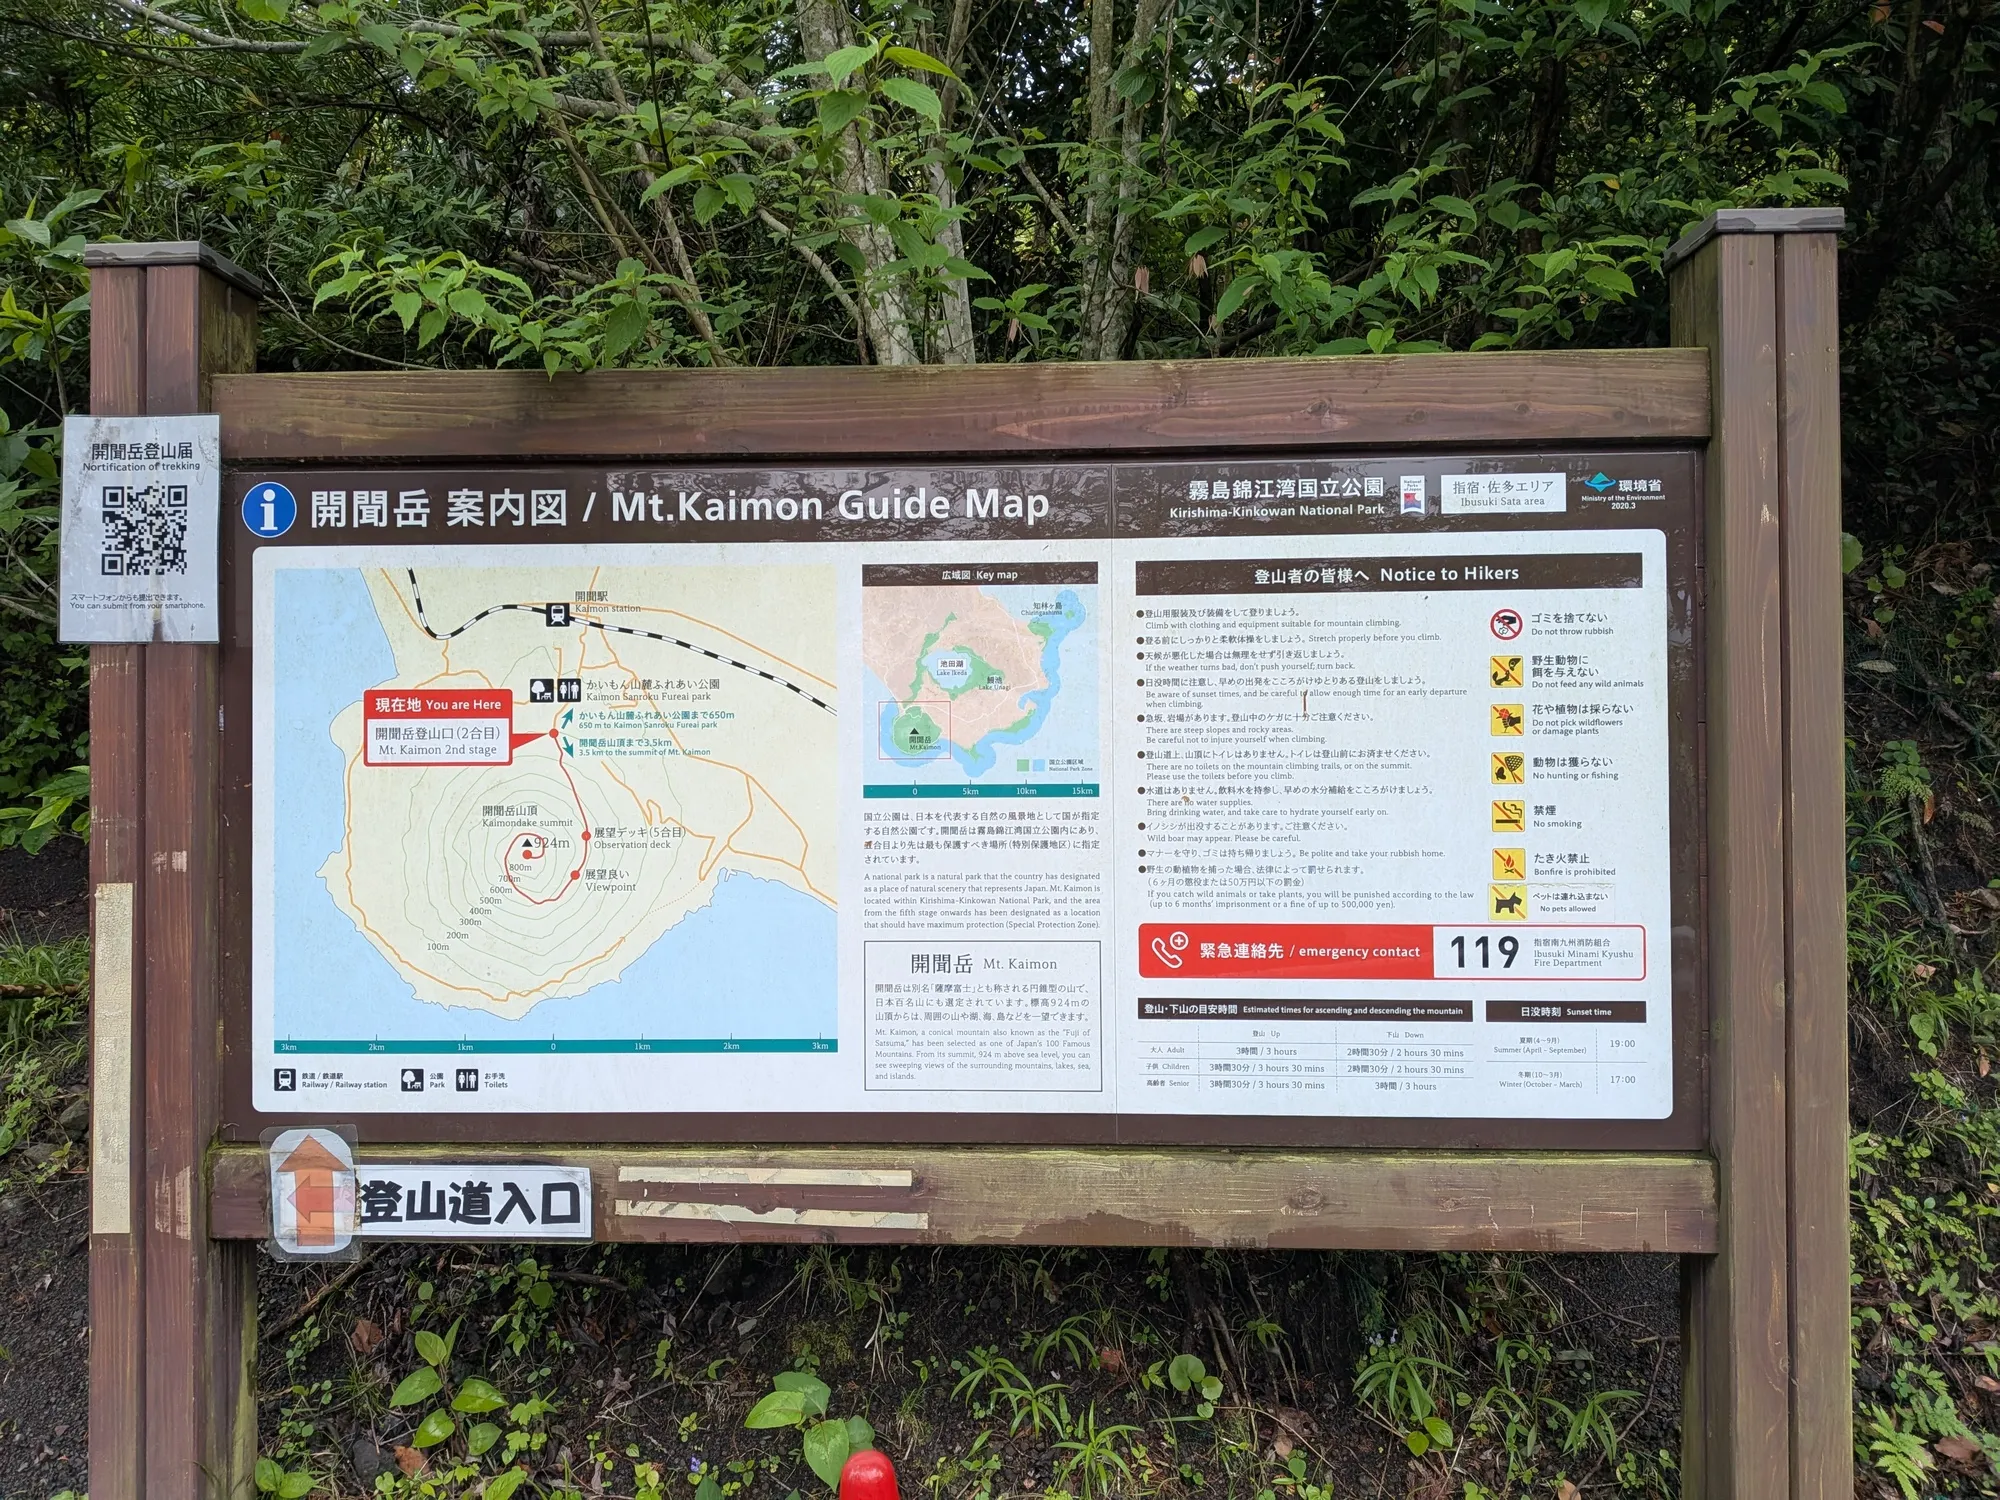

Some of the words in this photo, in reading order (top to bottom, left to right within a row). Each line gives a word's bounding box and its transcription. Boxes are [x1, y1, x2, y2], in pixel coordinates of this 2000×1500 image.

[92, 442, 193, 460] 開聞岳登山届
[83, 463, 145, 471] Nortification
[148, 462, 160, 471] of
[162, 462, 200, 471] trekking
[1189, 477, 1384, 501] 霧島錦江湾国立公園
[1619, 479, 1662, 492] 環境省
[1461, 497, 1497, 507] Ibusuki
[1501, 497, 1521, 506] Sata
[312, 489, 430, 528] 開聞岳
[446, 488, 566, 527] 案内図
[612, 490, 823, 522] Mt.Kaimon
[838, 488, 949, 520] Guide
[966, 489, 1049, 525] Map
[1170, 506, 1295, 518] Kirishima-Kinkowan
[1300, 504, 1353, 516] National
[1357, 503, 1384, 515] Park
[942, 570, 971, 580] 広域図
[976, 570, 994, 581] Key
[997, 571, 1018, 581] map
[1255, 567, 1369, 584] 登山者の皆様へ
[1381, 567, 1435, 581] Notice
[1441, 568, 1458, 580] to
[1465, 566, 1519, 580] Hikers
[575, 605, 609, 613] Kaimon
[612, 605, 641, 613] station
[1532, 612, 1608, 624] ゴミを捨てない
[1189, 621, 1220, 630] clothing
[1238, 621, 1279, 630] equipment
[1281, 620, 1311, 628] suitable
[1365, 618, 1401, 628] climbing.
[940, 660, 964, 668] 池田湖
[1532, 655, 1588, 666] 野生動物に
[586, 678, 720, 690] かいもん山麓ふれあい公園
[586, 692, 620, 701] Kaimon
[623, 692, 659, 701] Sanroku
[662, 692, 689, 700] Fureai
[692, 692, 711, 702] park
[376, 697, 421, 712] 現在地
[426, 700, 448, 710] You
[474, 699, 501, 709] Here
[1532, 704, 1634, 715] 花や植物は採らない
[379, 745, 396, 755] Mt.
[400, 745, 441, 755] Kaimon
[445, 744, 465, 754] 2nd
[469, 746, 496, 757] stage
[1533, 756, 1613, 768] 動物は獲らない
[1547, 772, 1579, 781] hunting
[1591, 771, 1619, 781] fishing
[962, 787, 979, 795] 5km
[1016, 787, 1037, 795] 10km
[1072, 787, 1093, 795] 15km
[482, 805, 538, 817] 開聞岳山頂
[1534, 805, 1556, 816] 禁煙
[482, 819, 537, 827] Kaimondake
[1547, 820, 1582, 829] smoking
[534, 838, 570, 848] 924m
[1534, 853, 1590, 864] たき火禁止
[584, 869, 629, 880] 展望良い
[1534, 868, 1563, 876] Bonfire
[1574, 868, 1616, 877] prohibited
[585, 883, 636, 892] Viewpoint
[1533, 892, 1608, 900] ペットは連れ込まない
[1534, 938, 1610, 947] 指宿南九州消防組合
[1200, 942, 1284, 959] 緊急連絡先
[1299, 948, 1369, 960] emergency
[1373, 947, 1420, 957] contact
[1451, 936, 1519, 968] 119
[1534, 950, 1564, 958] Ibusuki
[1602, 950, 1634, 960] Kyushu
[912, 954, 973, 974] 開聞岳
[984, 958, 1004, 969] Mt.
[1009, 958, 1057, 969] Kaimon
[1553, 959, 1602, 968] Department
[1522, 1007, 1561, 1017] 日没時刻
[723, 1042, 740, 1050] 2km
[1610, 1040, 1635, 1048] 19:00
[1611, 1076, 1636, 1084] 17:00
[302, 1081, 329, 1090] Railway
[336, 1081, 362, 1090] Railway
[360, 1180, 580, 1225] 登山道入口
